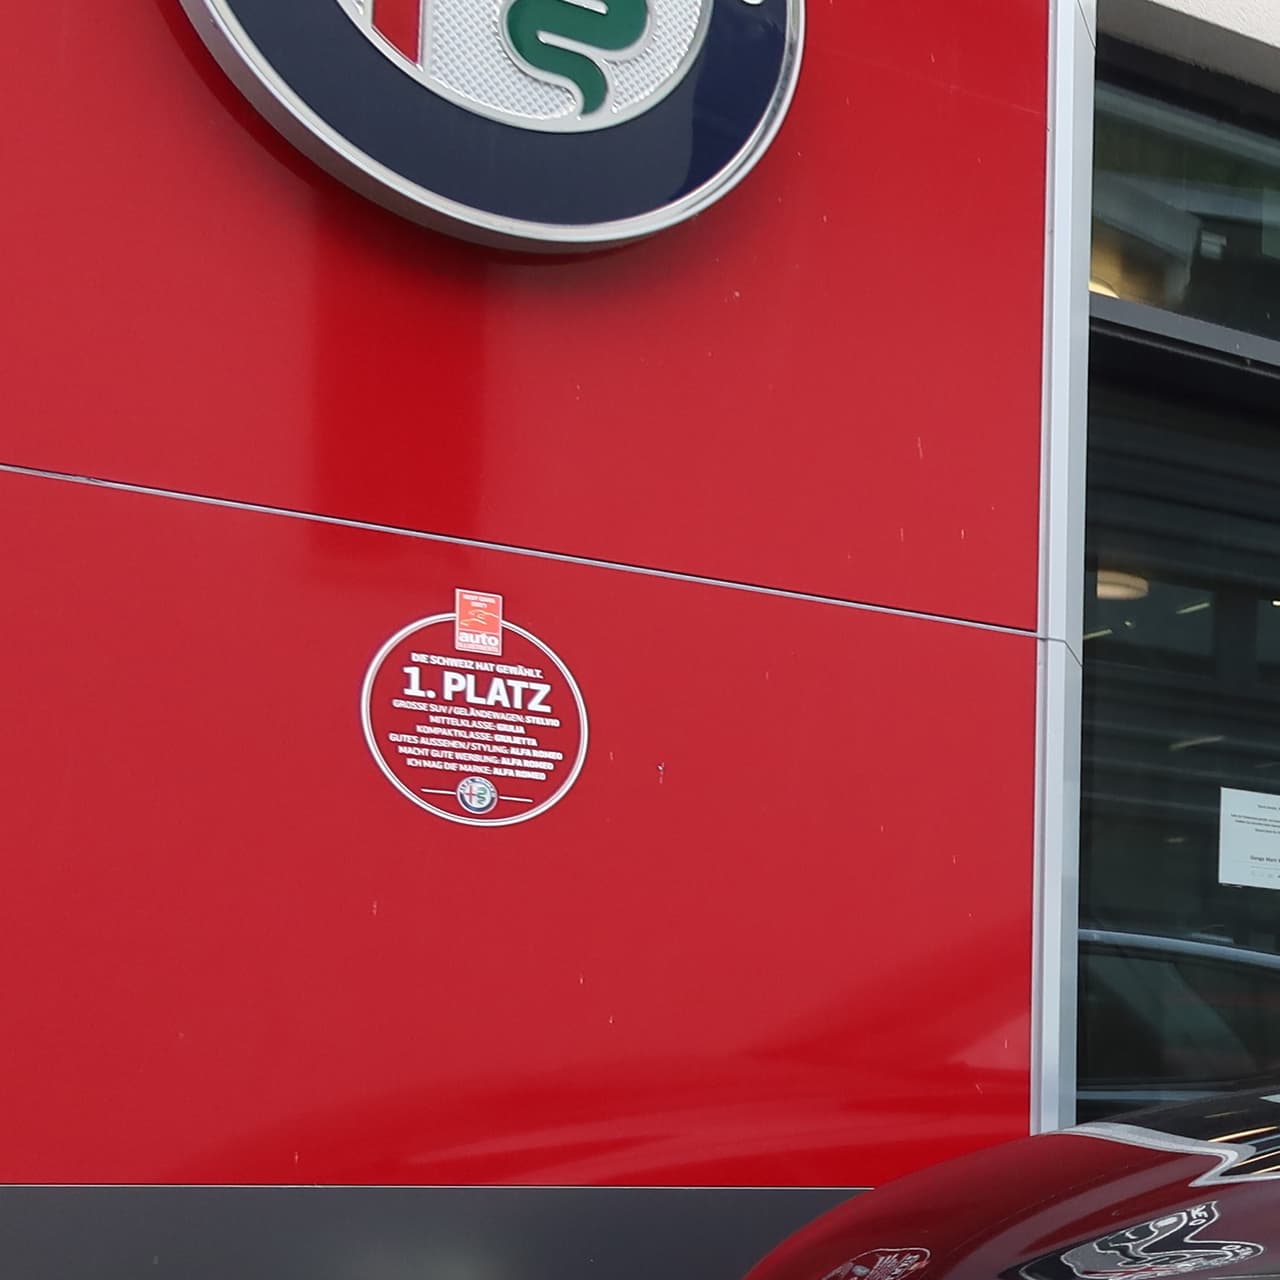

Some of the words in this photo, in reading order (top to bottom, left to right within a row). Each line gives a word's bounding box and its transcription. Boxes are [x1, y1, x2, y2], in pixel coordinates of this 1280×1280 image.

[459, 632, 499, 646] auto
[411, 653, 429, 663] DIE
[430, 656, 474, 669] SCHWEIZ
[475, 662, 495, 671] HAT
[403, 666, 436, 698] 1.
[444, 671, 551, 712] PLATZ
[431, 749, 454, 759] GUTE
[501, 757, 523, 767] ALFA
[510, 747, 532, 757] ALFA
[444, 762, 458, 771] DIE
[493, 767, 515, 777] ALFA
